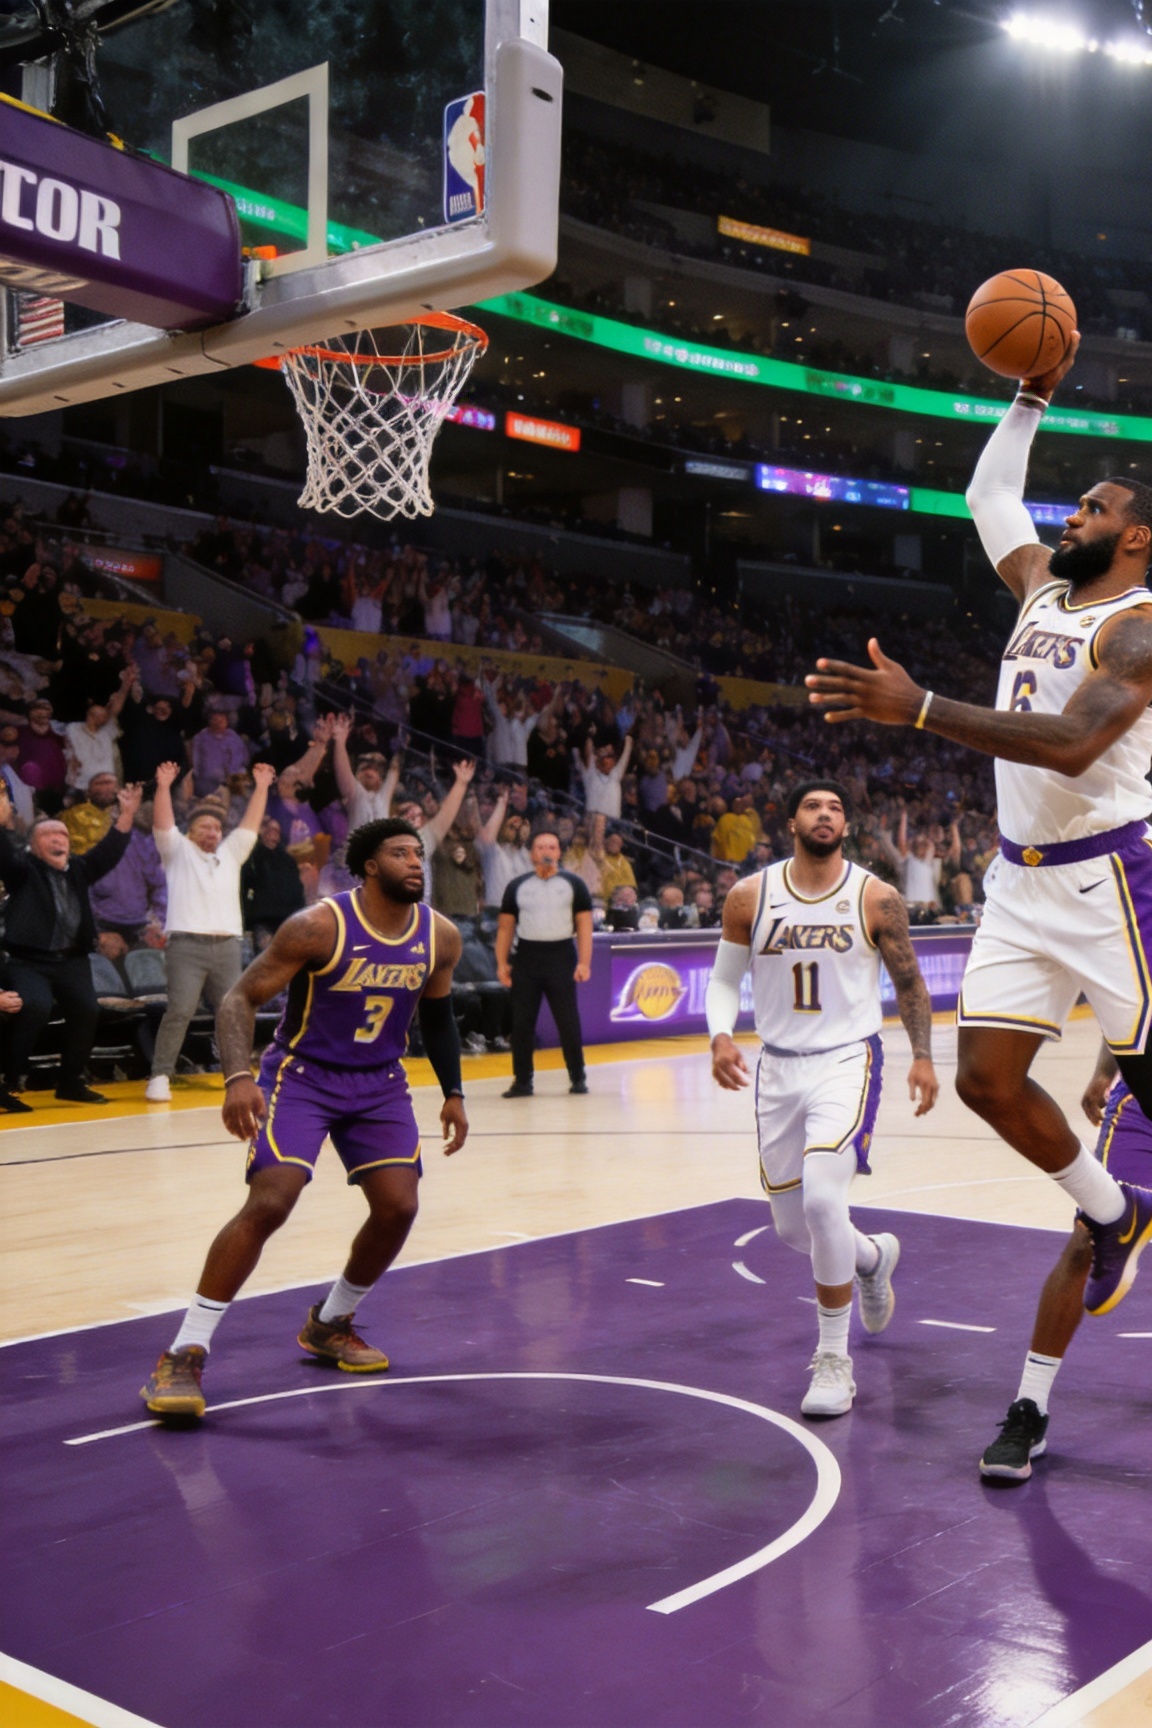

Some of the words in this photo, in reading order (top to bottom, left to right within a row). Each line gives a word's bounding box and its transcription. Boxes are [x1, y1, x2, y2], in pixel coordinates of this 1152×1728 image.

[758, 916, 854, 955] LAKERS
[792, 961, 822, 1014] 11
[353, 995, 395, 1044] 3
